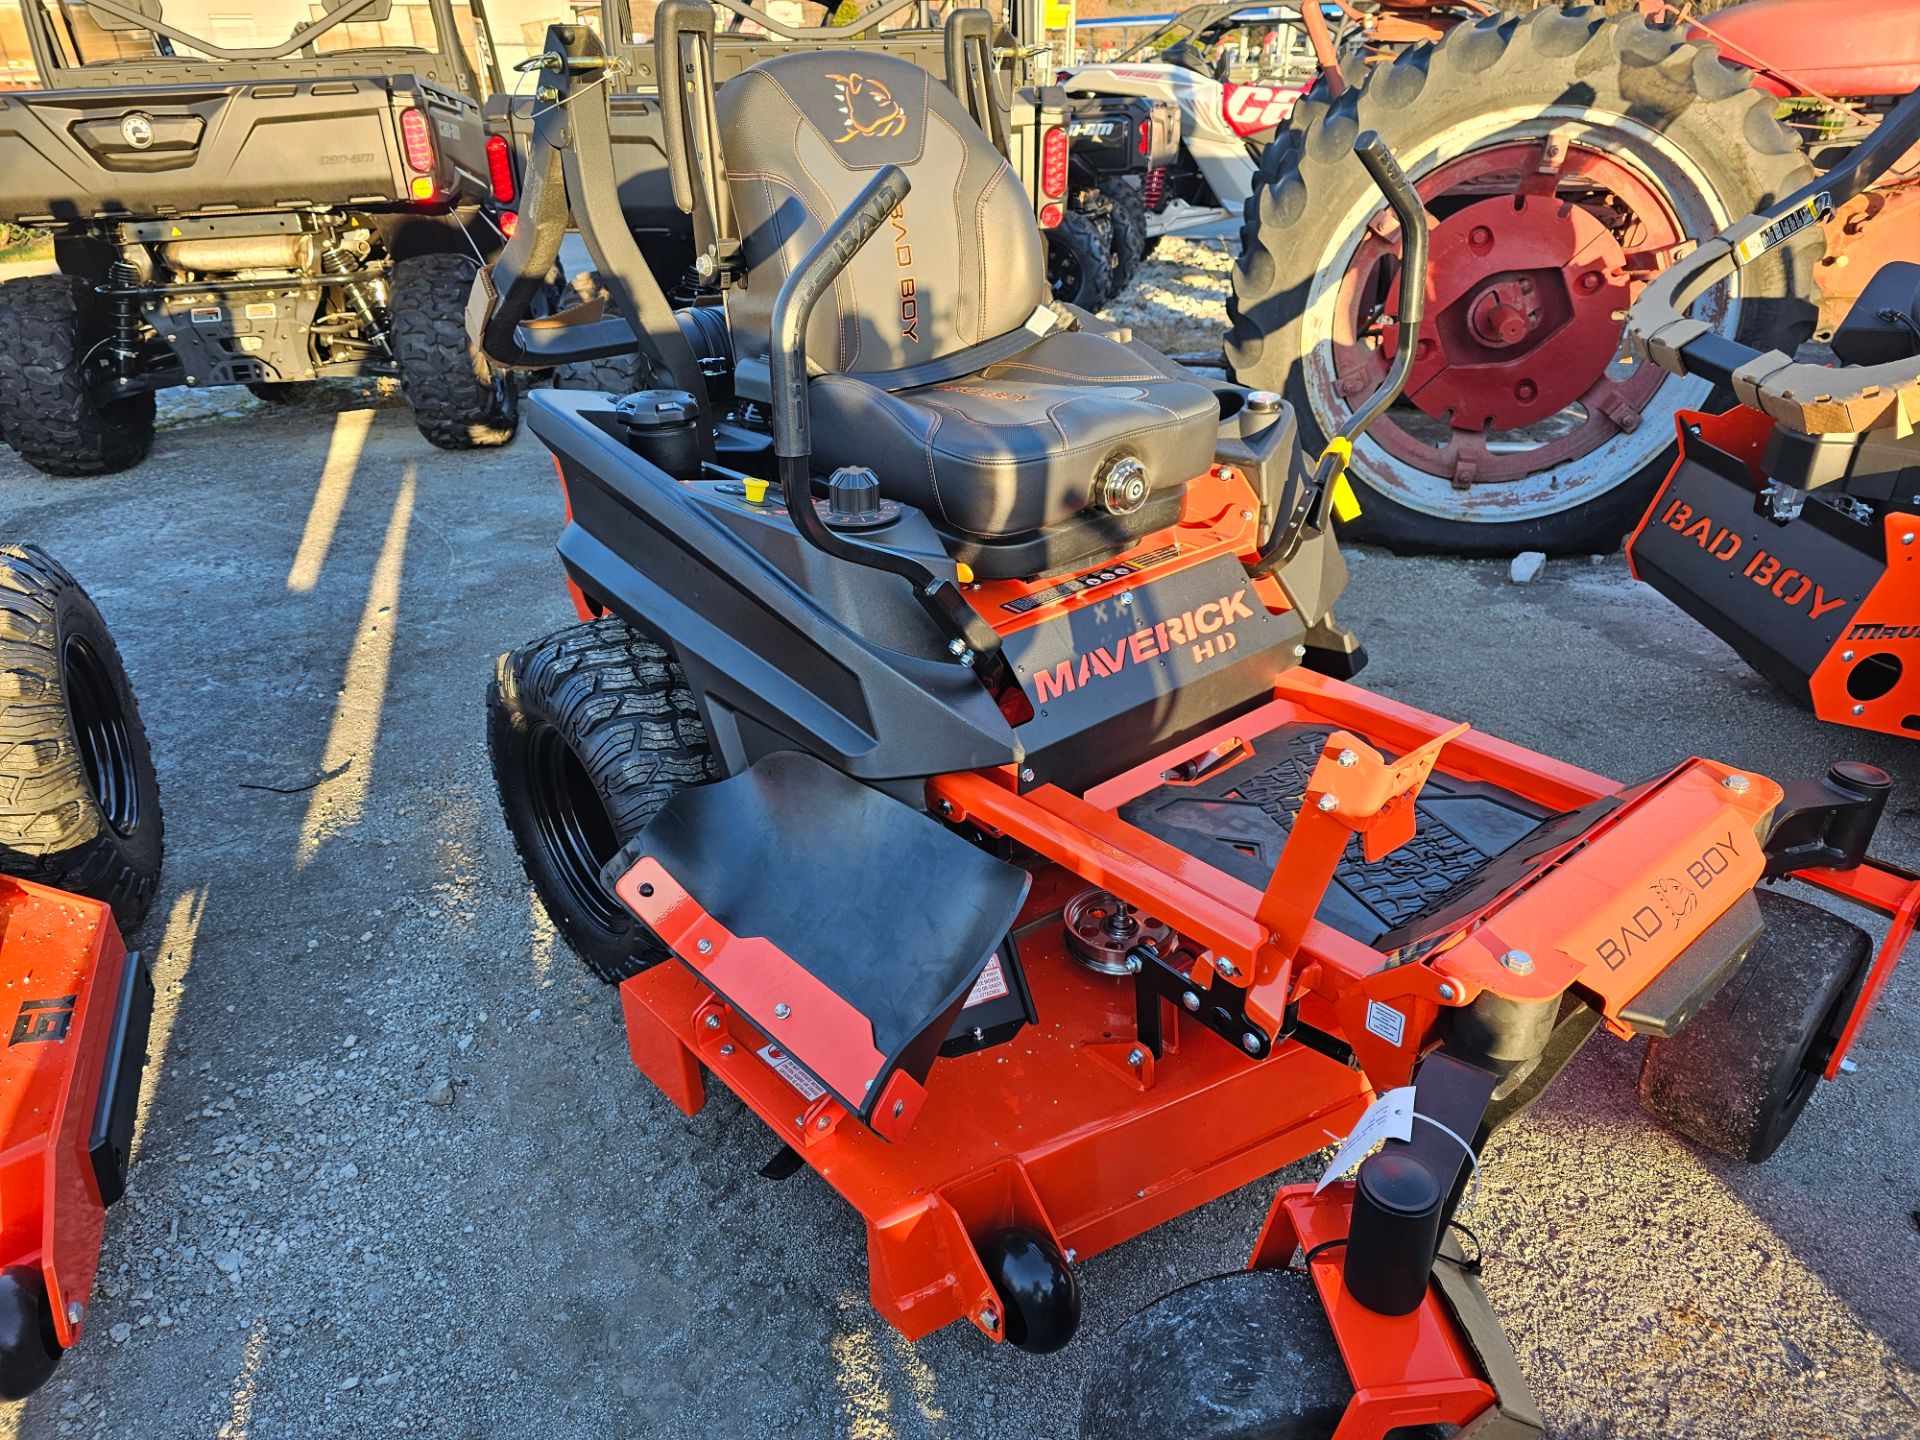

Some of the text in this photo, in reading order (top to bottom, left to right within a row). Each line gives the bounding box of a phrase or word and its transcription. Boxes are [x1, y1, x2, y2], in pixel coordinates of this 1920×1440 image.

[831, 184, 899, 265] BAD
[900, 277, 919, 343] BOY
[1660, 498, 1848, 620] BAD BOY
[1033, 588, 1255, 705] MAVERICK
[1191, 631, 1238, 664] HD
[1595, 831, 1740, 972] BAD BOY
